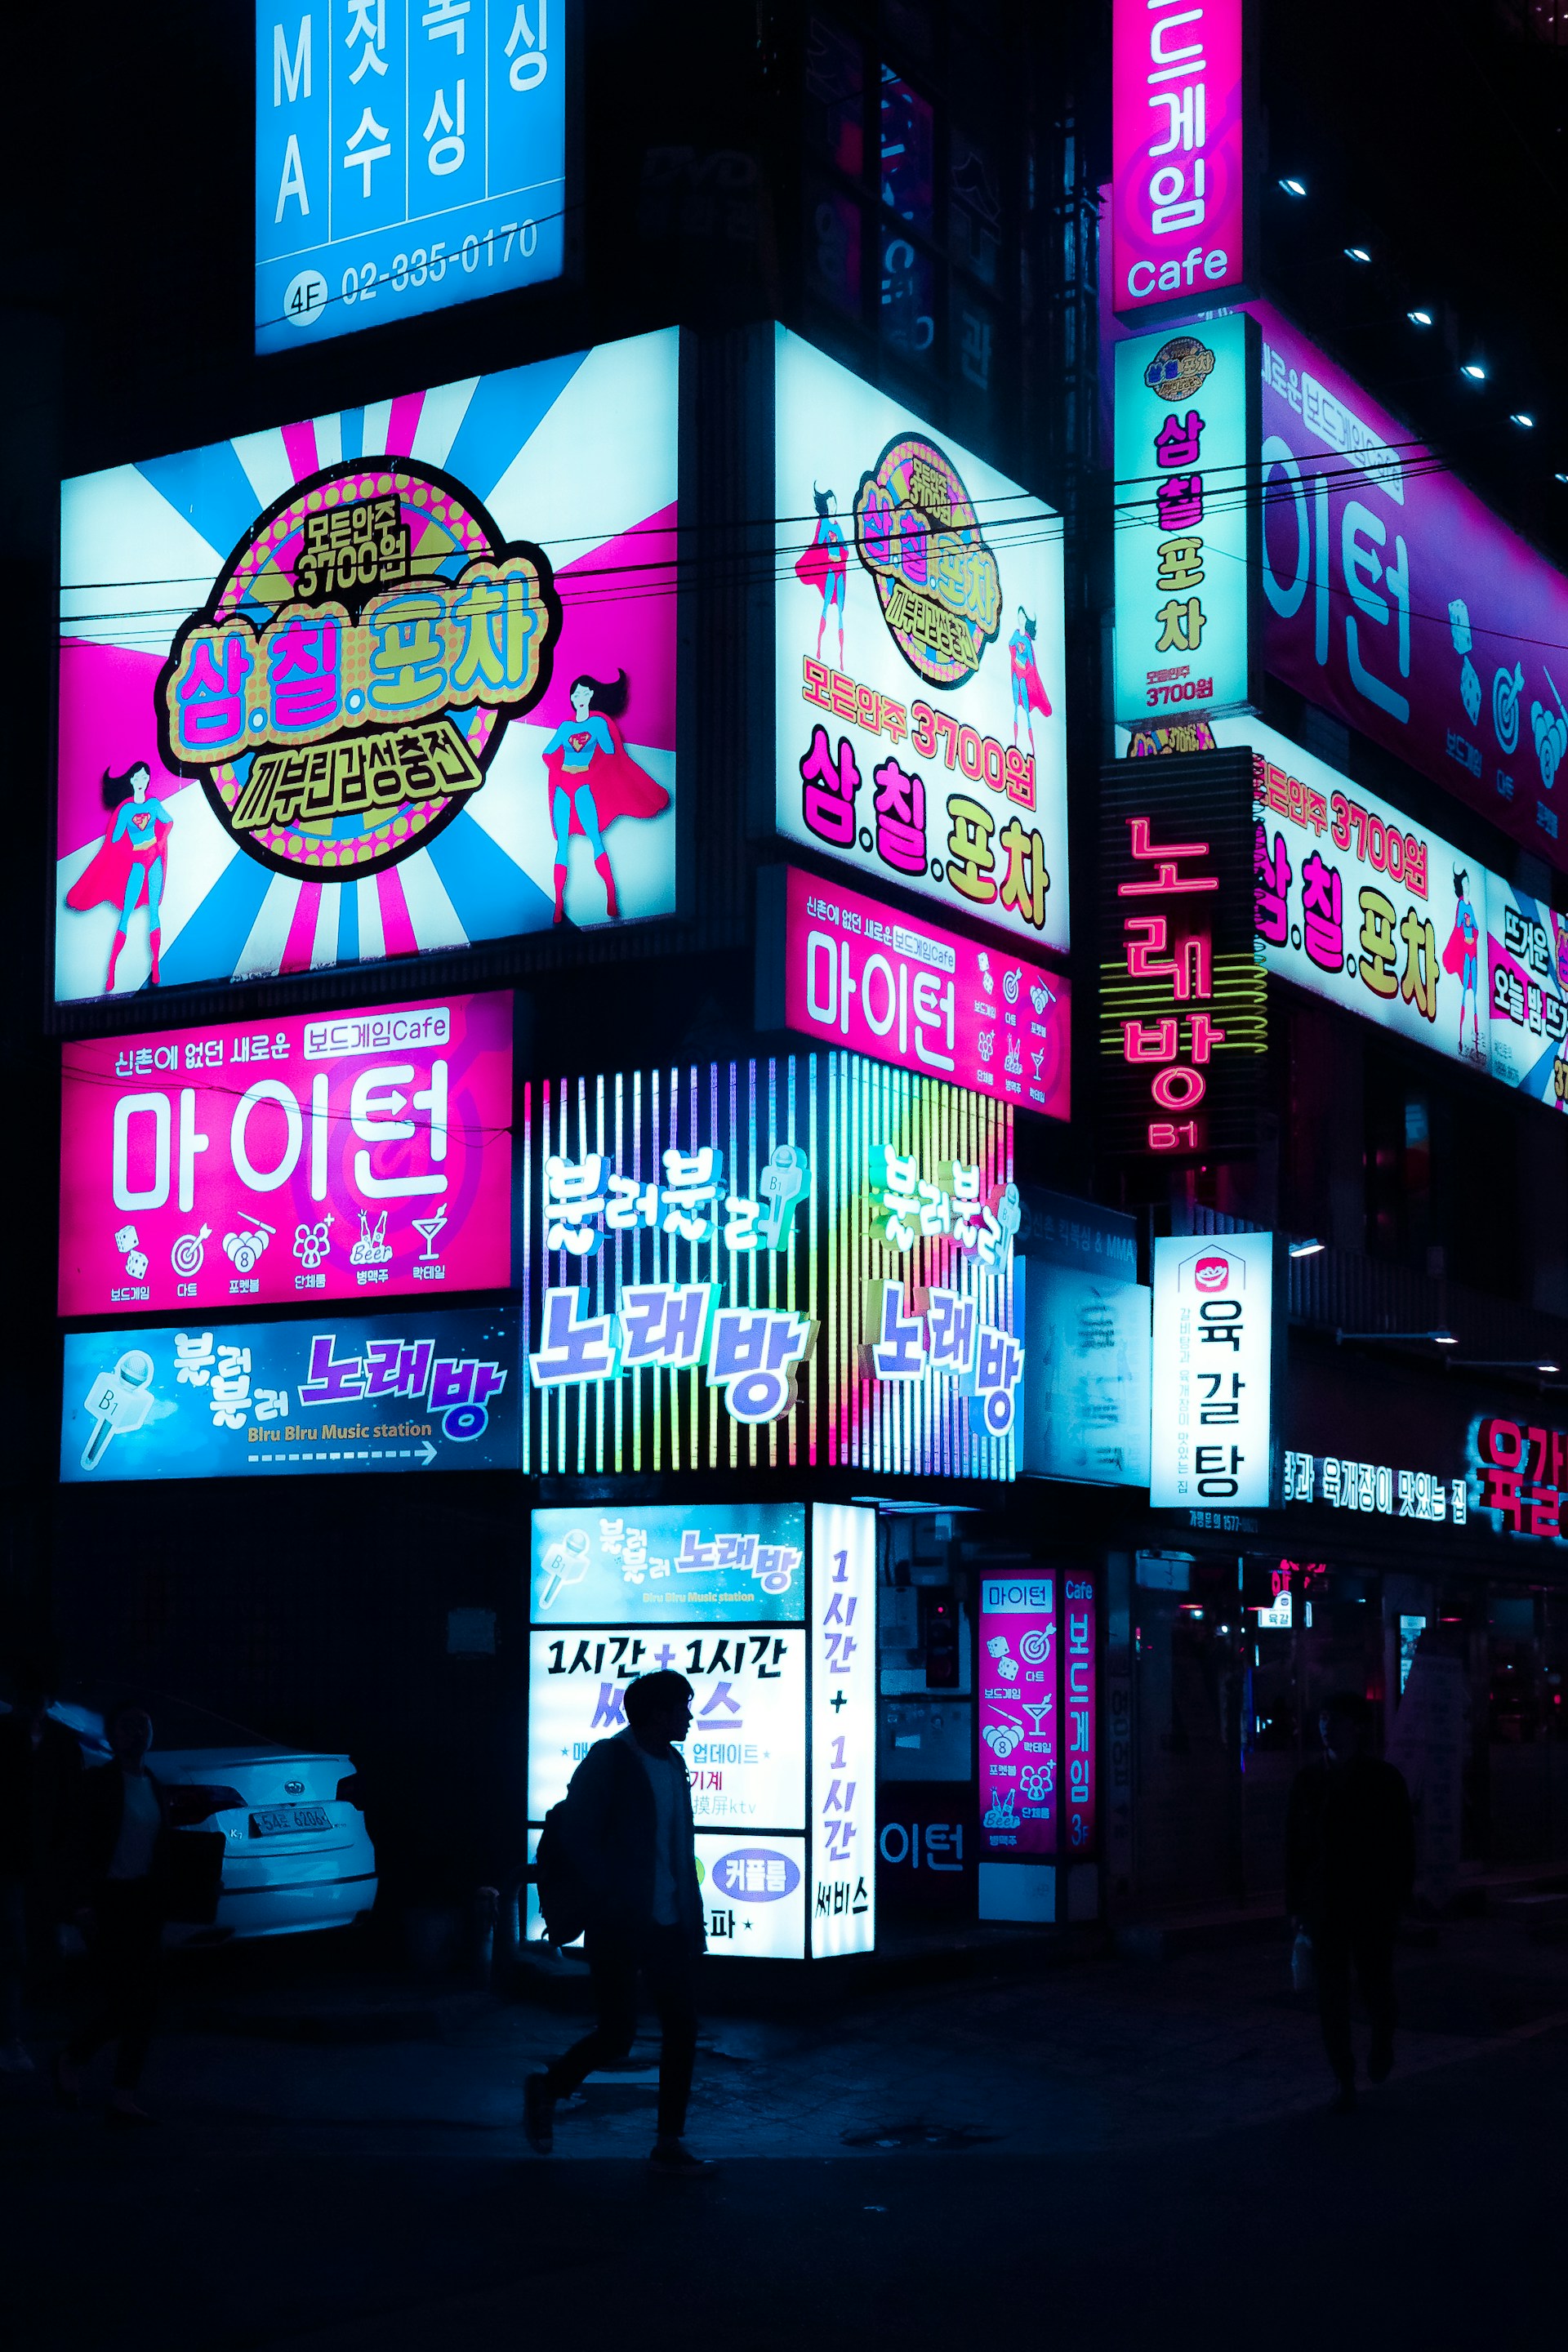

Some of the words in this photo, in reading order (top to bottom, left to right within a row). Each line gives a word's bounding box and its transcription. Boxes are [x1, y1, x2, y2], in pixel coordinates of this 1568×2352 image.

[1146, 0, 1207, 235] 드게임
[290, 282, 321, 312] 4F
[341, 218, 538, 305] 02-335-0170
[1128, 247, 1228, 297] Cafe
[307, 498, 397, 555] 모든안주
[297, 529, 407, 597] 3700원
[1146, 676, 1214, 707] 3700원
[802, 654, 908, 745] 모든안주
[910, 699, 1037, 813] 3700원
[1331, 788, 1429, 902] 3700원
[806, 895, 840, 925] 신촌에
[842, 908, 862, 935] 없던
[864, 915, 893, 947] 새로운
[1117, 817, 1225, 1110] 노래방
[806, 929, 955, 1071] 마이턴
[1494, 964, 1525, 1027] 오늘
[1527, 982, 1544, 1038] 밤
[115, 1043, 179, 1078] 신촌에
[185, 1039, 224, 1070] 없던
[229, 1032, 291, 1064] 새로운
[112, 1058, 449, 1214] 마이턴
[1148, 1120, 1198, 1148] B1
[769, 1175, 782, 1192] B1
[353, 1241, 392, 1263] Beer
[110, 1286, 150, 1303] 보드게임
[176, 1283, 198, 1298] 다트
[229, 1279, 261, 1295] 포켓볼
[294, 1274, 327, 1290] 단체룸
[356, 1270, 390, 1286] 병맥주
[528, 1281, 812, 1424] 노래방
[872, 1278, 1026, 1437] 노래방
[97, 1389, 118, 1417] B1
[297, 1334, 508, 1442] 노래방
[1194, 1299, 1246, 1499] 육갈탕
[321, 1423, 370, 1440] Music
[372, 1421, 432, 1438] station
[1177, 1480, 1189, 1494] 집
[1323, 1457, 1392, 1514] 육개장이
[1398, 1470, 1446, 1521] 맛있는
[1452, 1479, 1466, 1525] 집
[550, 1555, 566, 1574] B1
[673, 1530, 804, 1595] 노래방
[688, 1591, 718, 1602] Music
[719, 1590, 755, 1602] station
[823, 1549, 858, 1673] 1시간
[988, 1586, 1047, 1606] 마이턴
[1065, 1580, 1094, 1601] Cafe
[547, 1637, 646, 1678] 1시간
[685, 1636, 788, 1678] 1시간
[1025, 1670, 1045, 1682] 다트
[984, 1688, 1021, 1700] 보드게임
[1069, 1613, 1089, 1803] 보드게임
[693, 1743, 759, 1765] 업데이트
[822, 1735, 858, 1862] 1시간
[987, 1813, 1021, 1827] Beer
[230, 1829, 243, 1840] K7
[1071, 1813, 1089, 1846] 3F
[815, 1876, 869, 1919] 써비스
